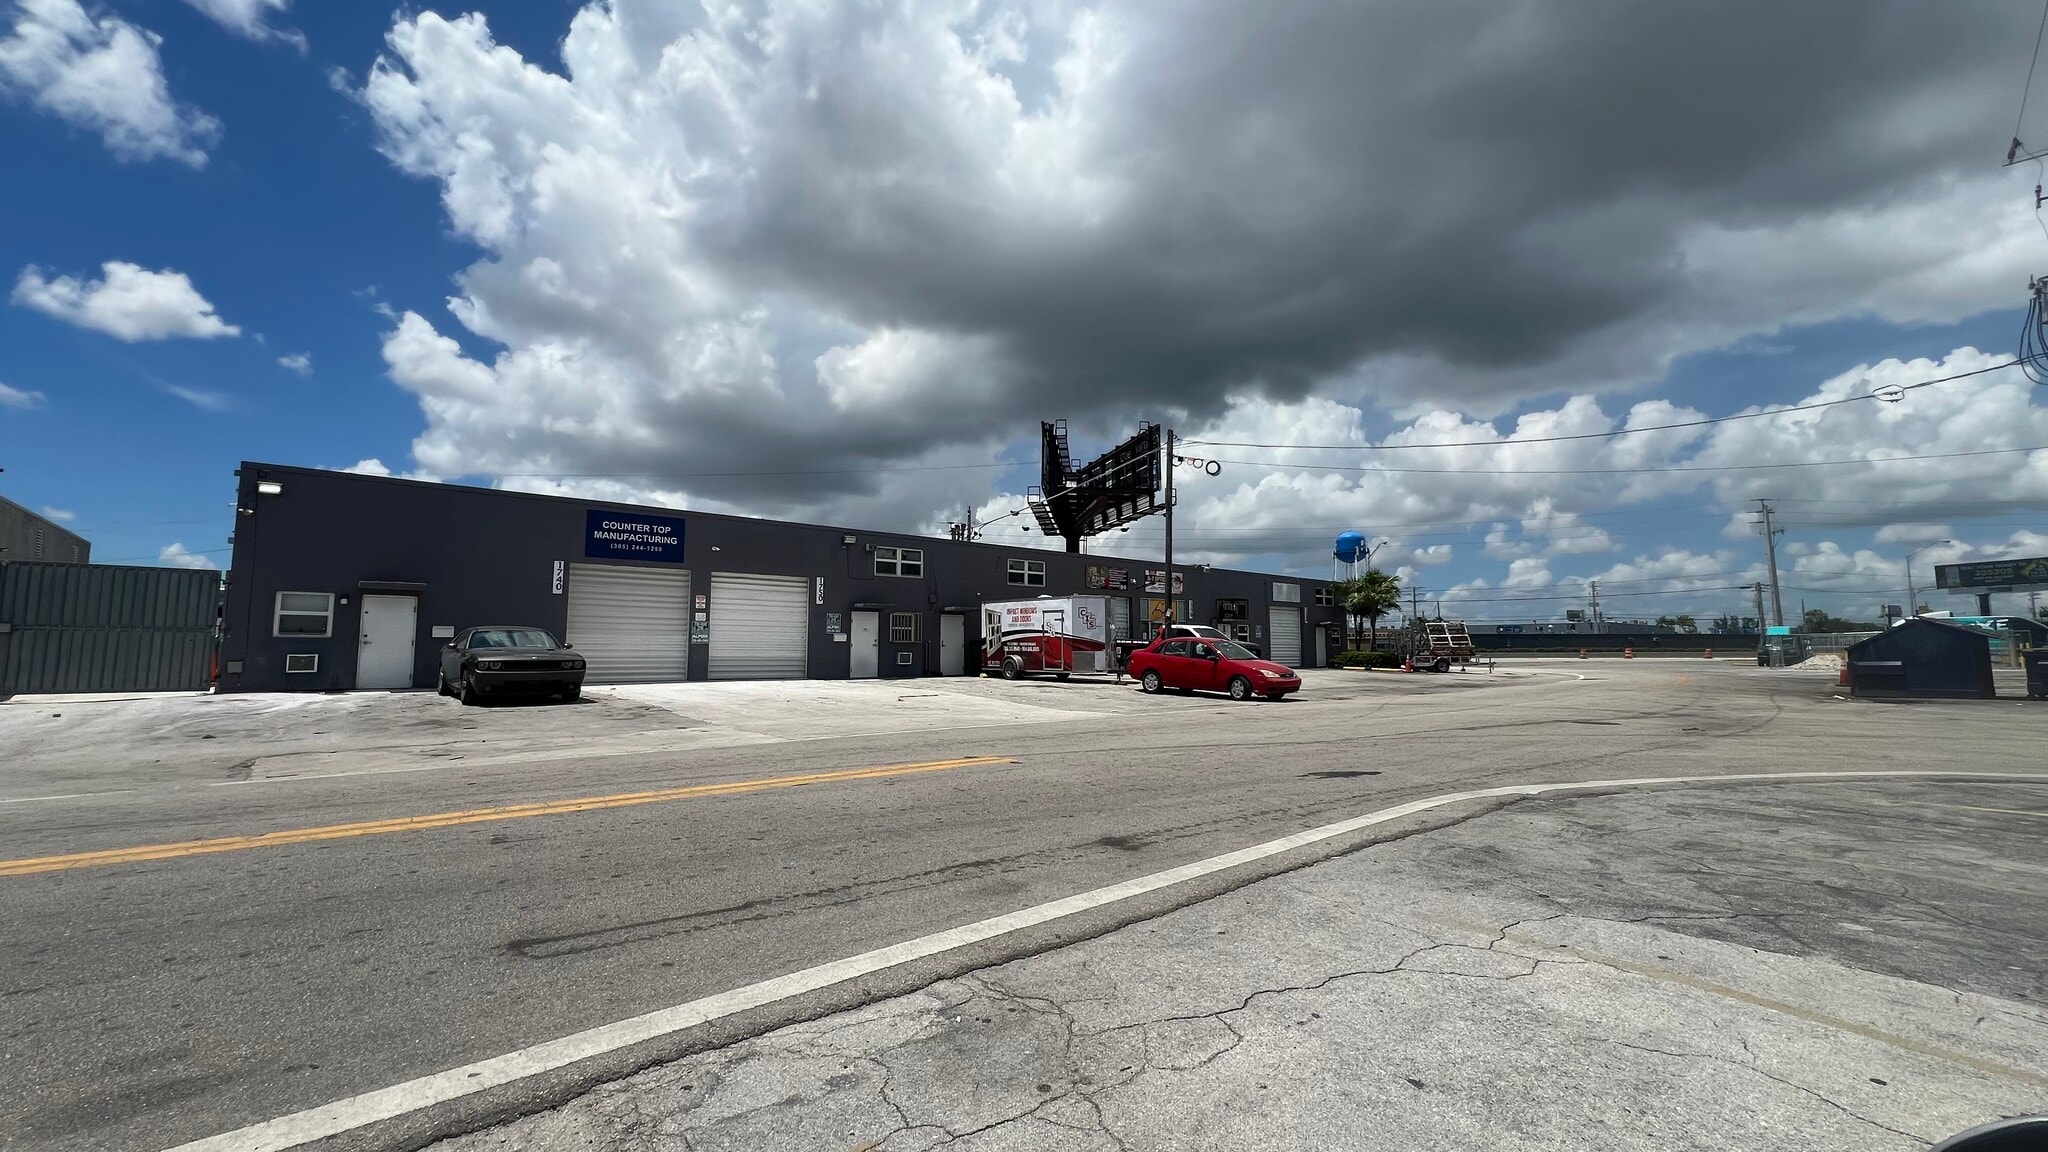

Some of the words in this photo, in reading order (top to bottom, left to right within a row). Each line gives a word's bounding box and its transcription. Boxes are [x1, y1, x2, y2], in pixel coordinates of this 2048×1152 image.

[602, 521, 650, 532] COUNTER
[652, 525, 671, 534] TOP
[594, 530, 678, 545] MANUFACTURING
[1974, 567, 2013, 576] 305305
